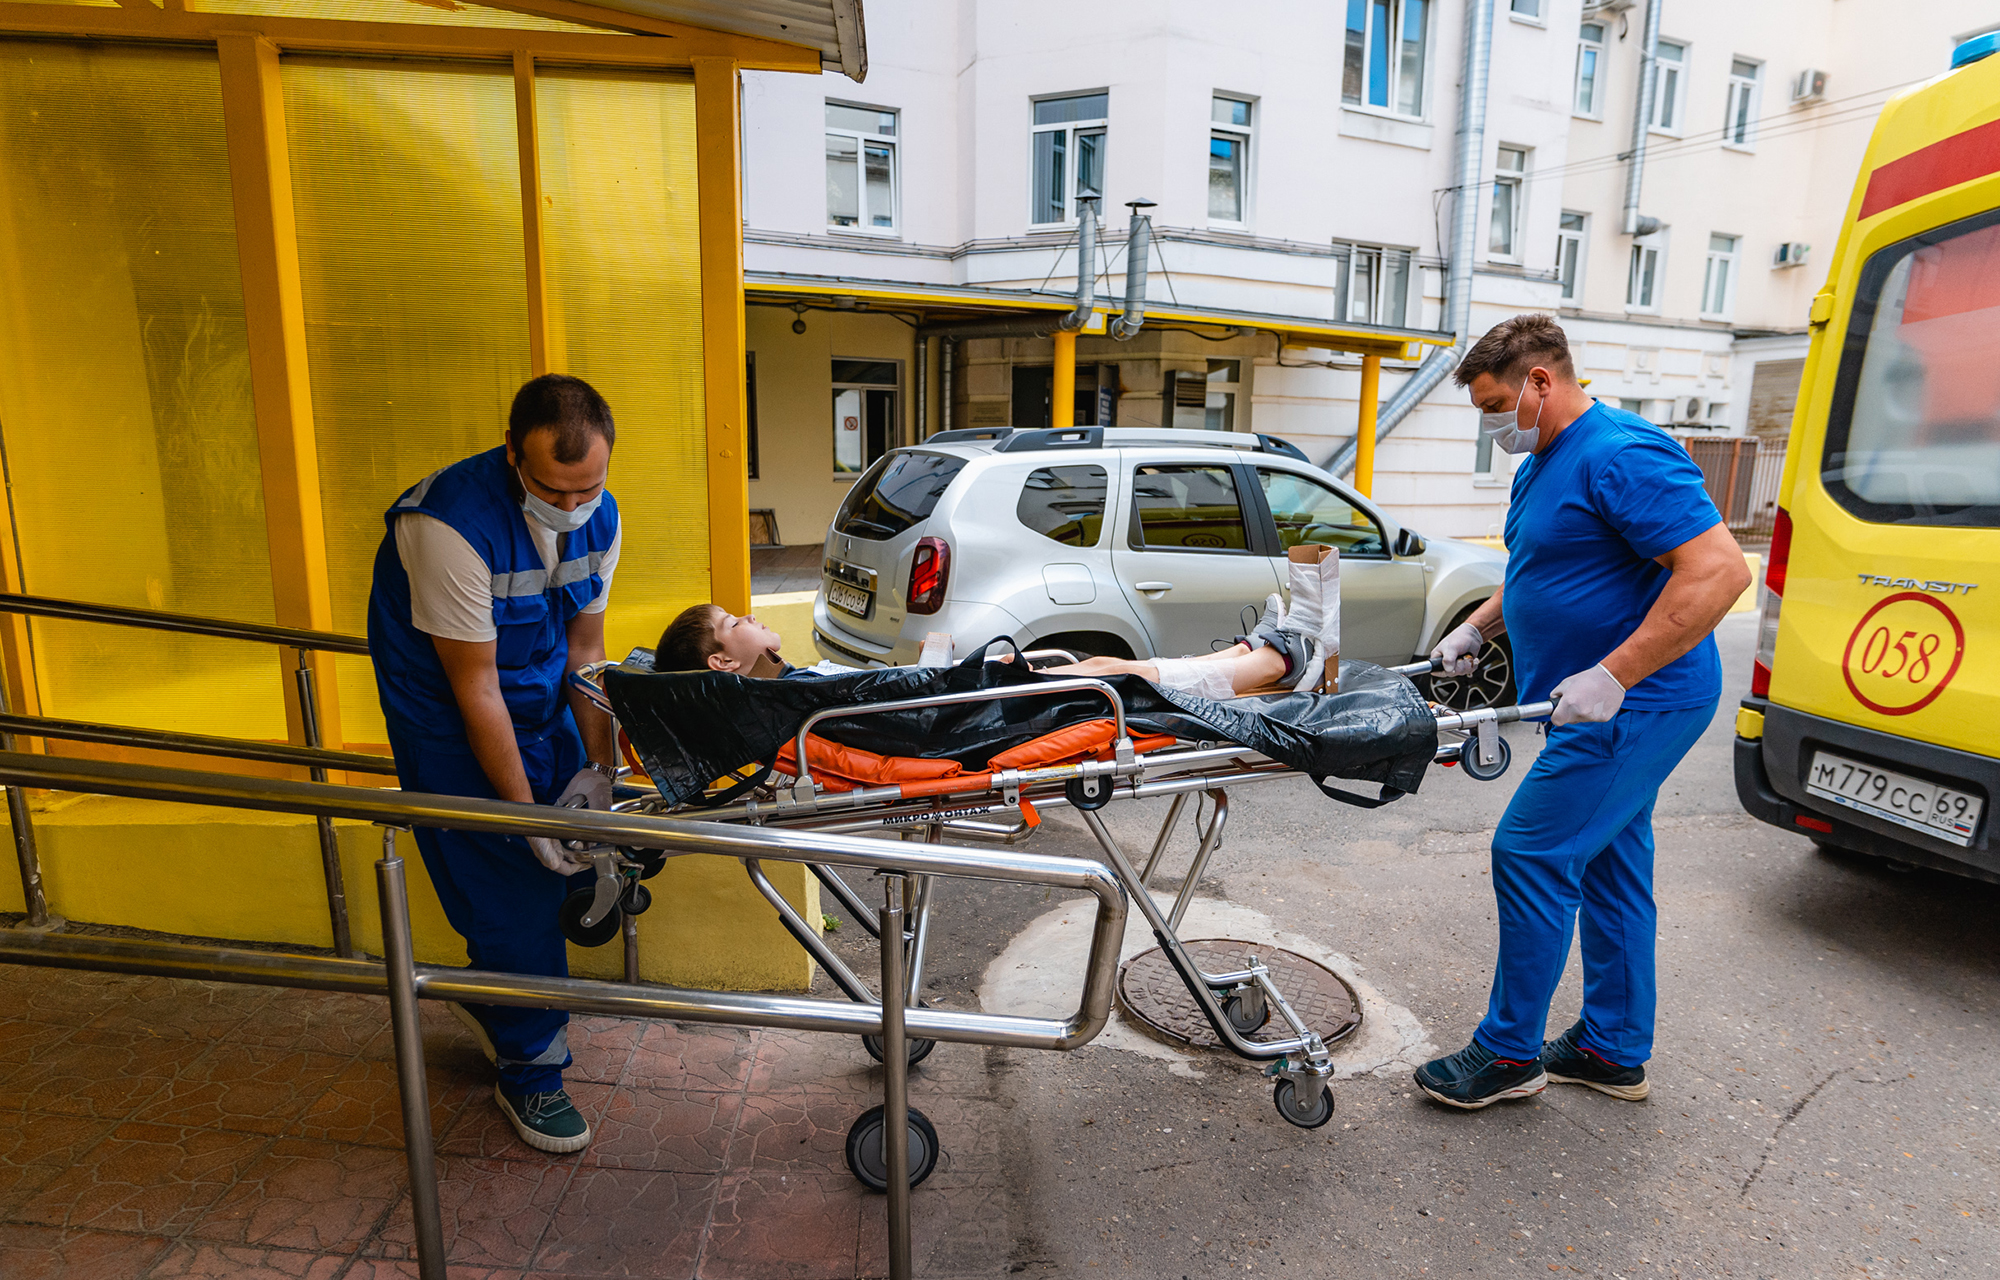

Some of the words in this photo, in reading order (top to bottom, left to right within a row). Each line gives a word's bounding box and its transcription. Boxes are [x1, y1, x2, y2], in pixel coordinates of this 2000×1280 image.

[1858, 573, 1979, 595] TRANSIT
[856, 591, 867, 608] 69
[1862, 626, 1940, 684] 058
[882, 805, 991, 826] МИКРОМОНТАЖ
[1935, 791, 1969, 819] 69
[1931, 813, 1955, 828] RUS
